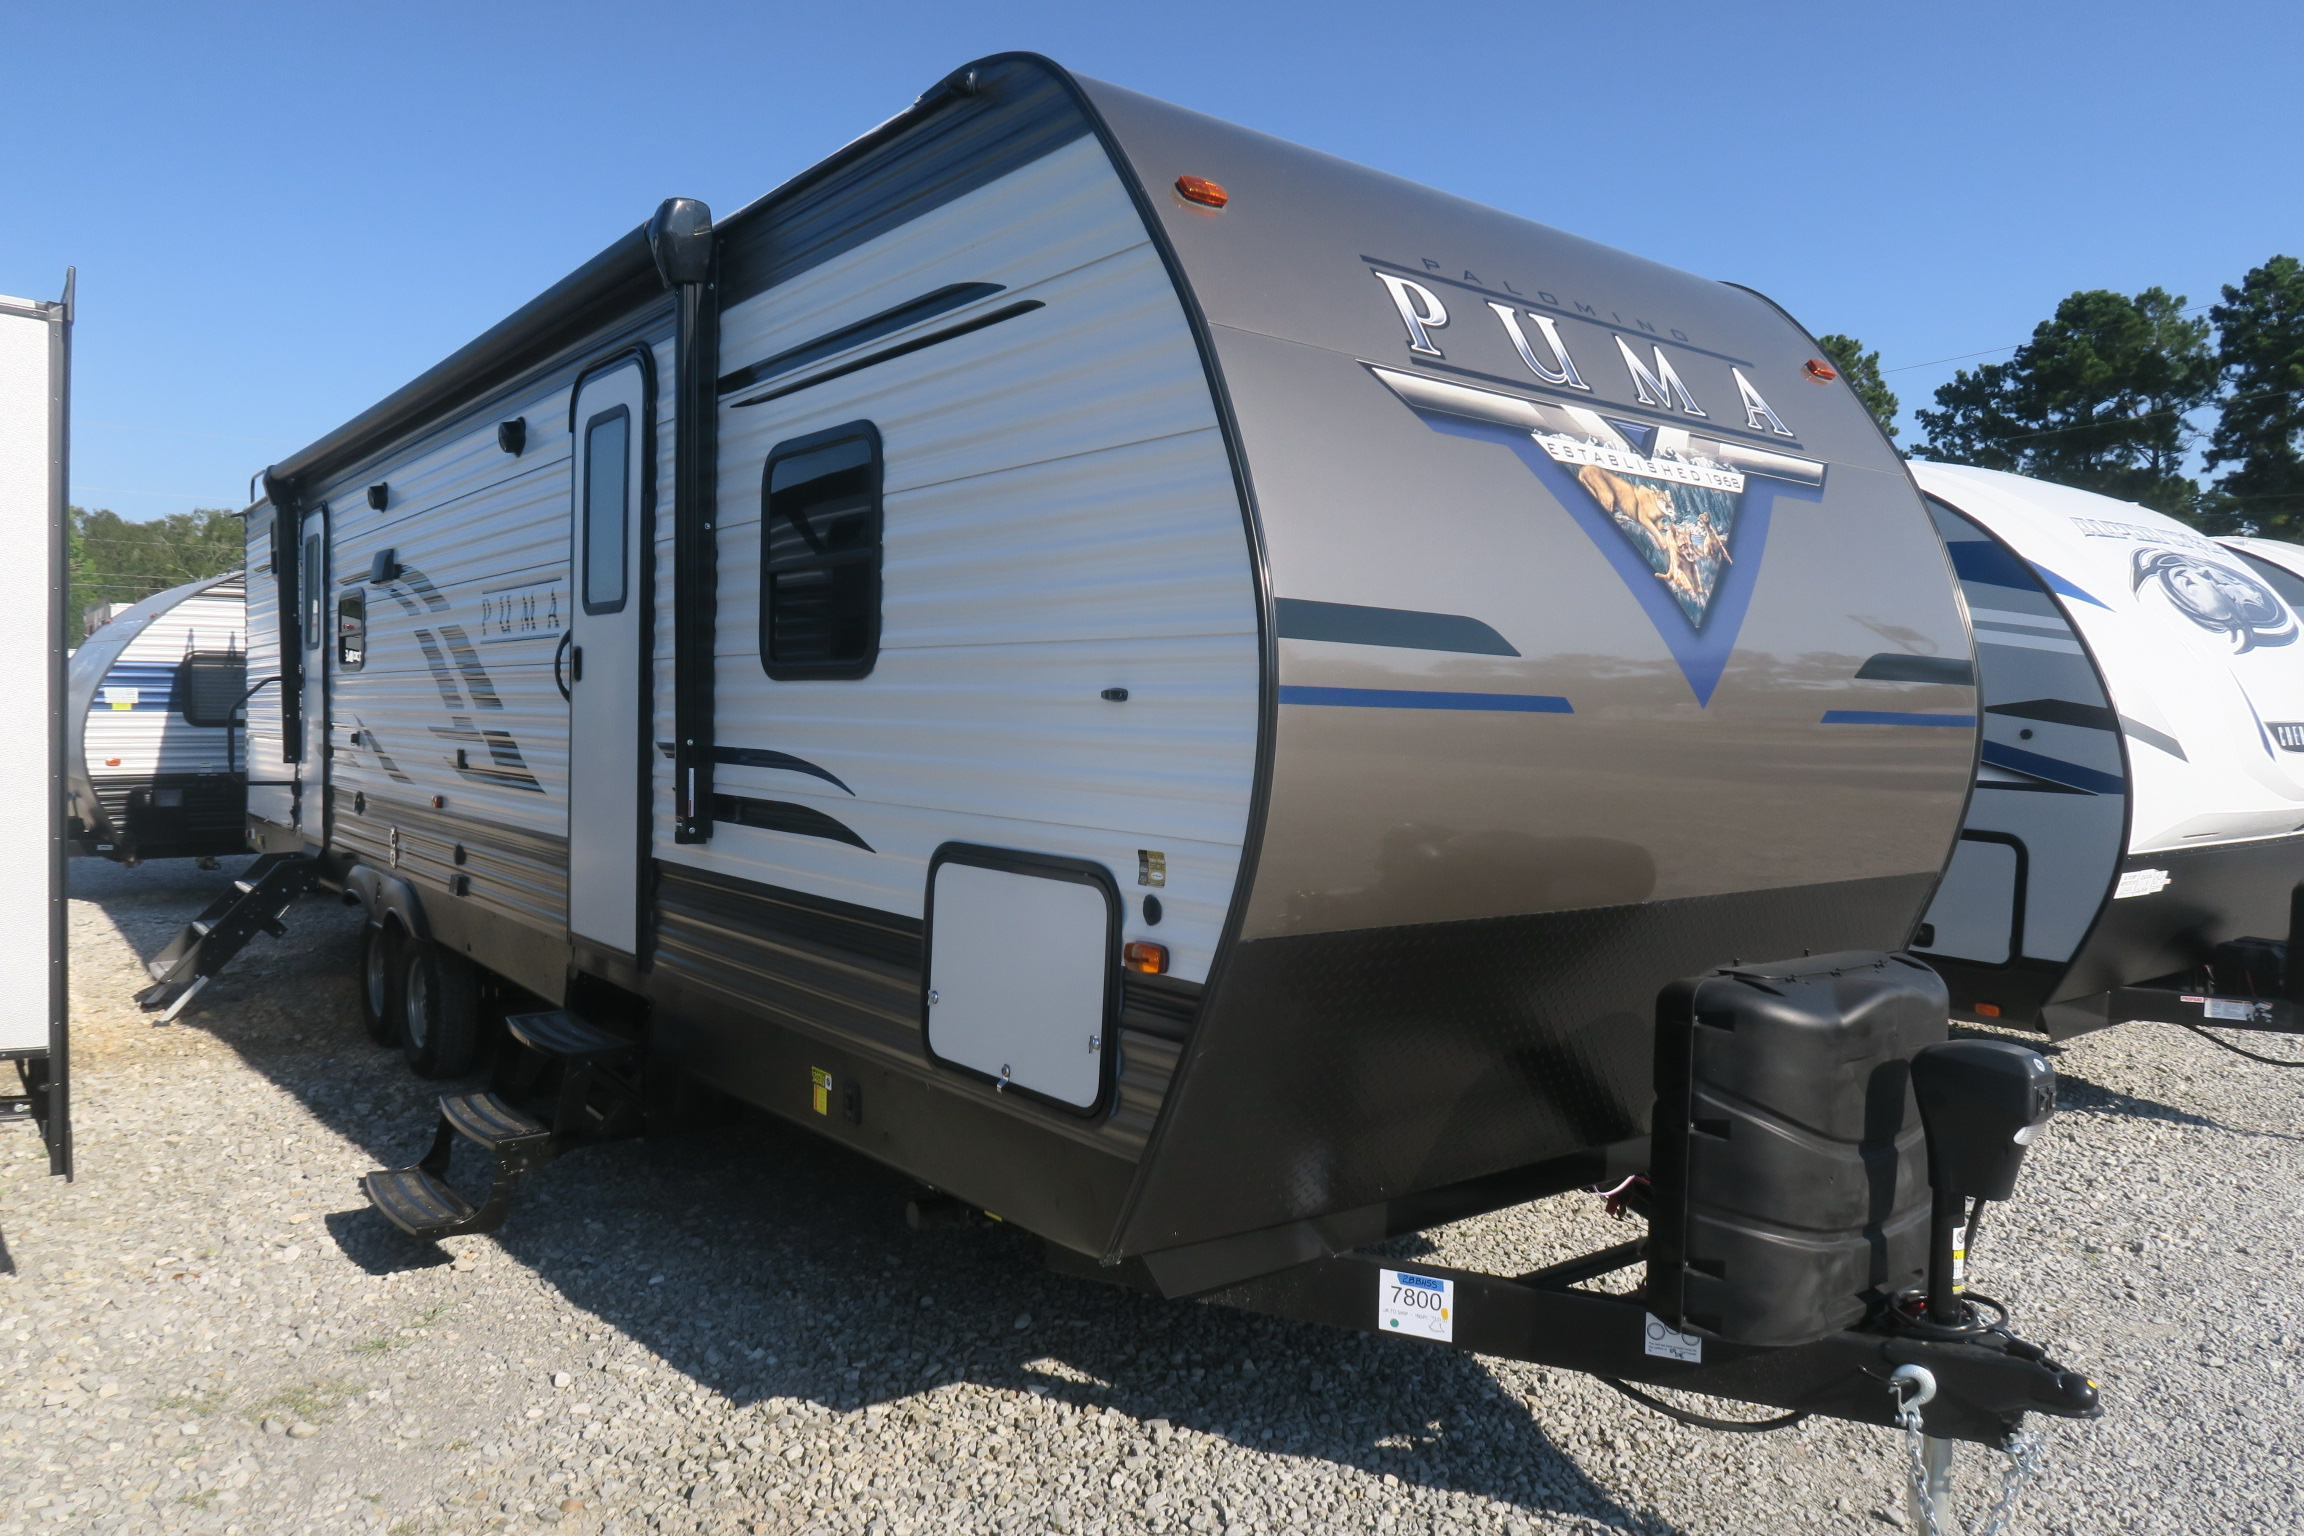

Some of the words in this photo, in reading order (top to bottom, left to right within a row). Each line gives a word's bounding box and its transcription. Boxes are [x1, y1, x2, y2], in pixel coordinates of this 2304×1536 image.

[1421, 257, 1689, 343] PALOMINO
[1370, 267, 1796, 439] PUMA
[1546, 442, 1701, 482] ESTABLISHED
[482, 586, 560, 636] PUMA
[1390, 1285, 1442, 1311] 7800
